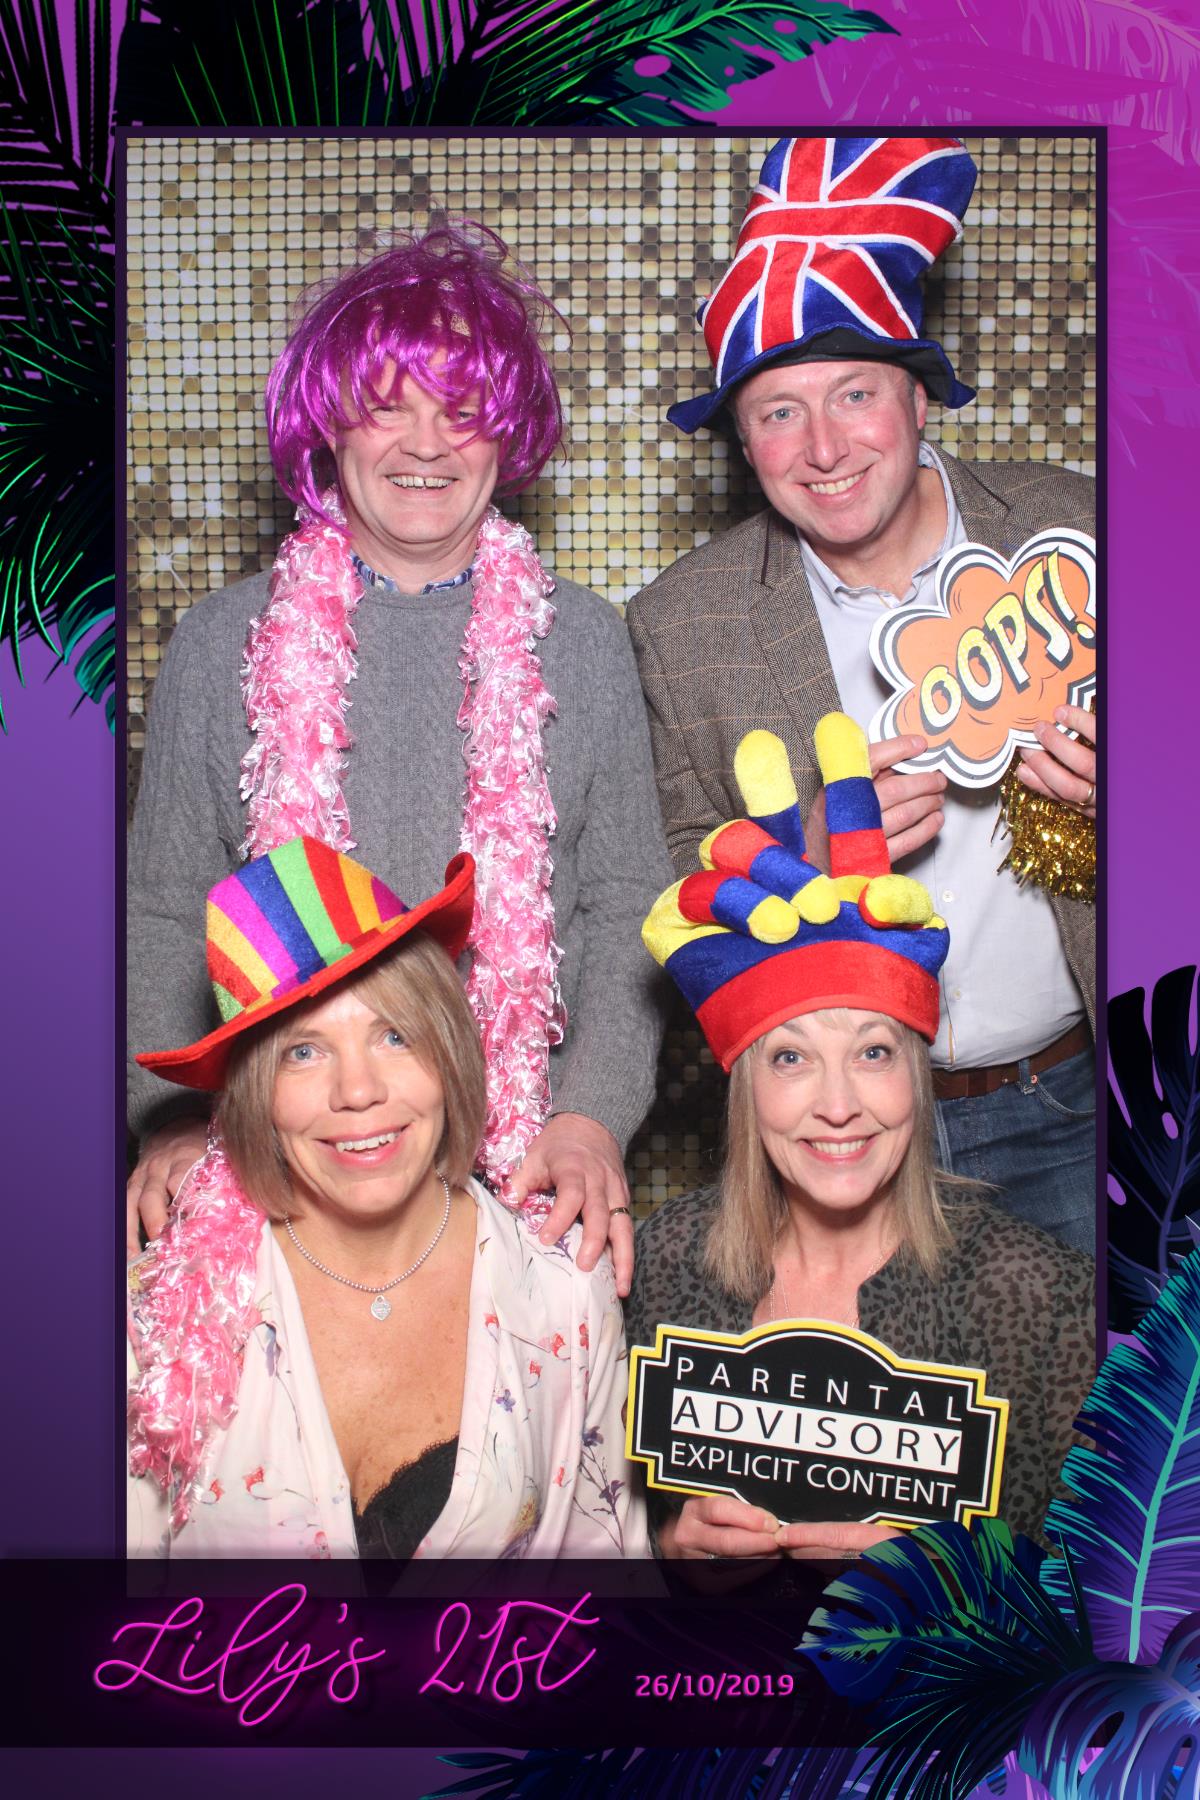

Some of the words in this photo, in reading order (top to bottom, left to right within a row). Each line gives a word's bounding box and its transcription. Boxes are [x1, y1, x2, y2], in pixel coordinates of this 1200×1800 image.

[920, 549, 1095, 735] OOPS!
[676, 1356, 963, 1423] PARENTAL
[672, 1395, 961, 1467] ADVISORY
[670, 1441, 800, 1484] EXPLICIT
[806, 1463, 957, 1508] CONTENT
